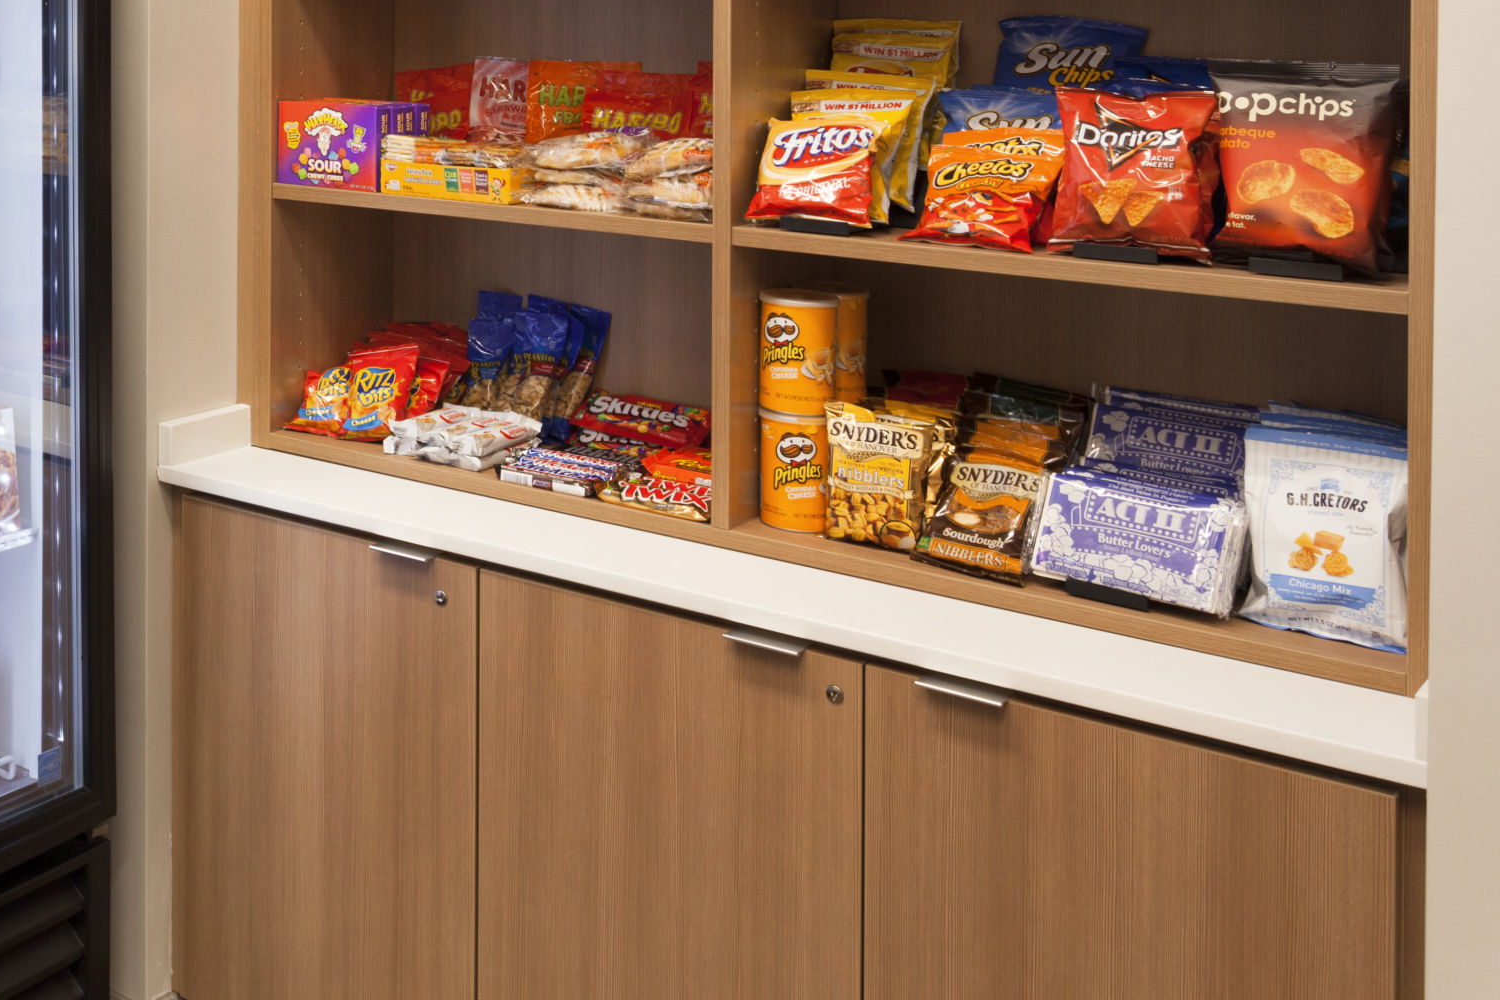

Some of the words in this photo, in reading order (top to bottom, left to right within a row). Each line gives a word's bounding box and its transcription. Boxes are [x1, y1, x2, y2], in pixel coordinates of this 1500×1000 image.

[863, 46, 884, 55] WIN
[900, 49, 939, 59] MILLION
[1014, 42, 1111, 75] Sun
[1048, 65, 1115, 89] Chips
[824, 102, 846, 111] WIN
[848, 102, 859, 111] $1
[861, 101, 902, 110] MILLION
[304, 113, 348, 131] WARHEADS
[593, 107, 682, 134] HARIBO
[1077, 120, 1182, 148] Doritos
[773, 125, 875, 167] Fritos
[308, 158, 342, 173] SOUR
[933, 158, 1034, 190] Cheetos
[763, 345, 805, 368] Pringles
[354, 368, 395, 388] RITZ
[358, 385, 394, 407] bits
[351, 415, 377, 427] Cheese
[590, 396, 690, 429] Skittles
[830, 421, 918, 450] SNYDER'S
[1138, 426, 1189, 450] ACT
[1190, 434, 1224, 454] II
[859, 443, 898, 455] HANOVER
[774, 465, 822, 488] Pringles
[837, 466, 905, 489] nibblers
[957, 465, 1041, 492] SNYDER'S
[619, 481, 711, 512] TWIX
[1313, 492, 1368, 513] CRETORS
[1096, 499, 1155, 525] ACT
[1153, 509, 1187, 532] II
[943, 528, 1004, 549] Sourdough
[1098, 533, 1134, 549] Butter
[1135, 539, 1171, 559] Lovers
[935, 543, 1003, 567] NIBBLERS
[1289, 577, 1330, 592] Chicago
[1332, 582, 1352, 596] Mix
